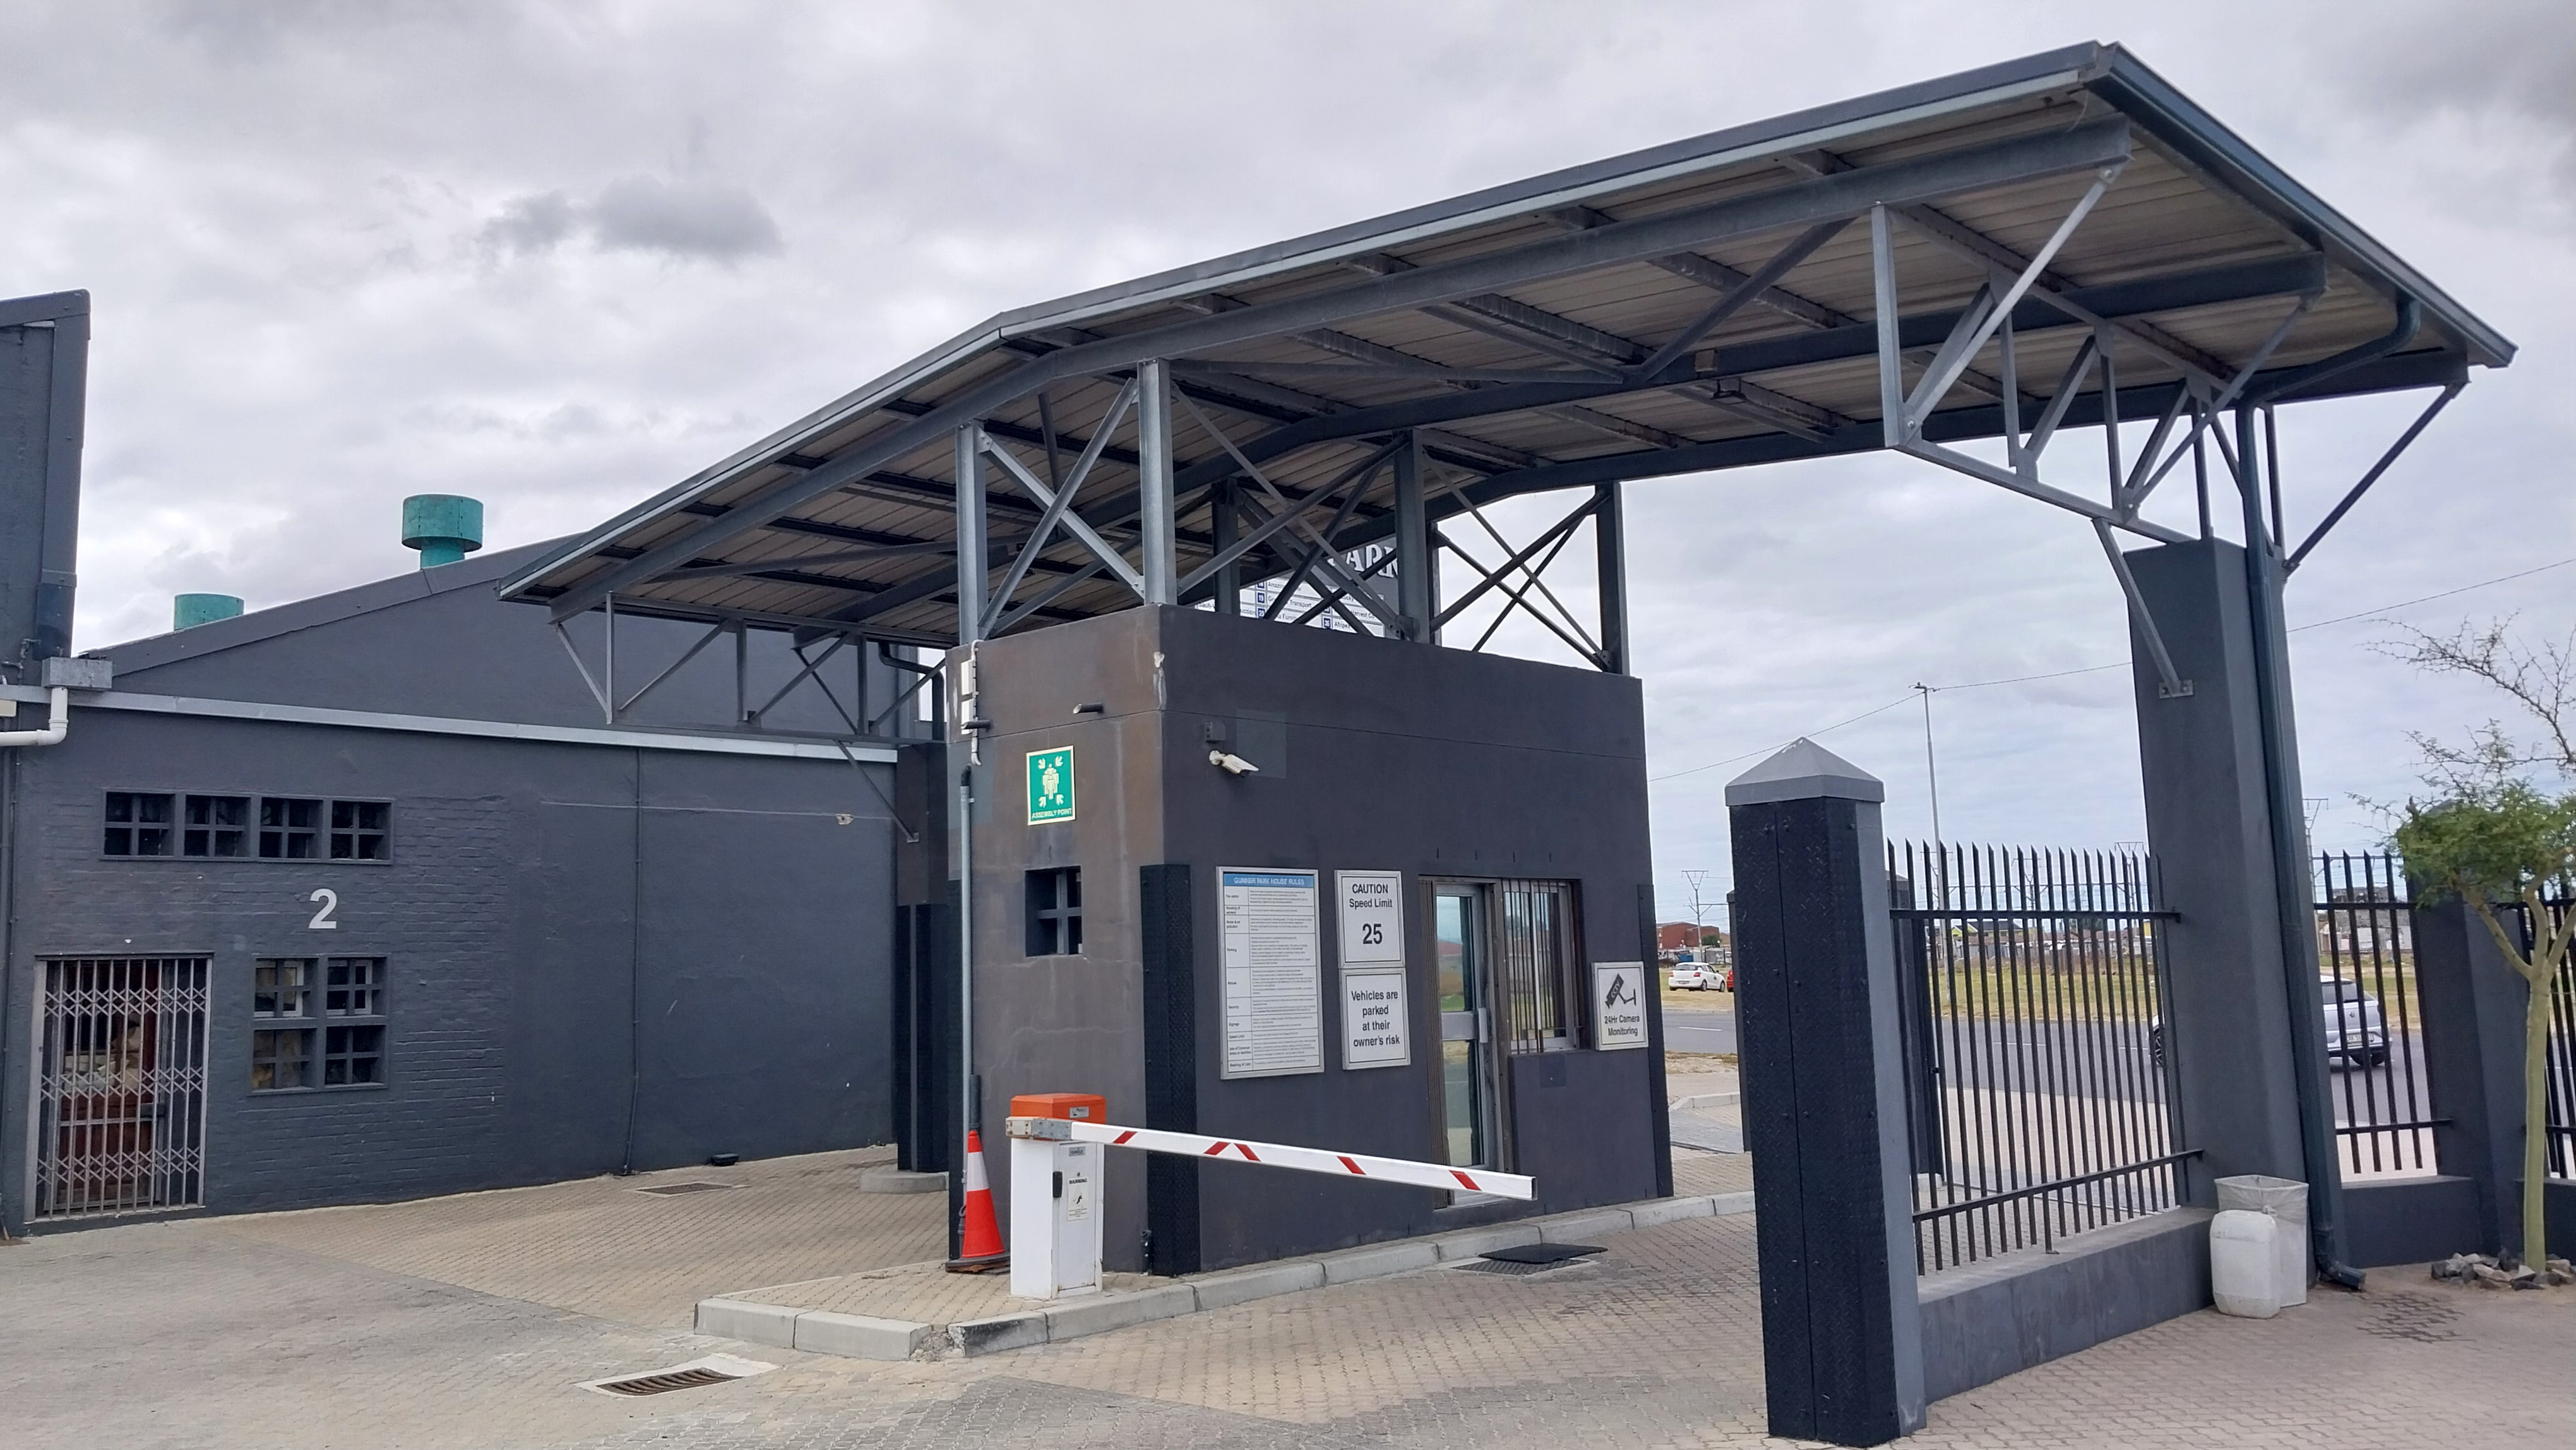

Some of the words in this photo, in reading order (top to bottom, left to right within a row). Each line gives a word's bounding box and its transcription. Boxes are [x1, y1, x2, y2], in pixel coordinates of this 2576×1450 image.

[1290, 599, 1312, 608] Transport
[1032, 810, 1057, 819] ASSEMBLY
[1058, 808, 1072, 816] POINT
[1352, 884, 1388, 894] CAUTION
[308, 888, 337, 929] 2
[1349, 898, 1372, 910] Speed
[1374, 898, 1393, 908] Limit
[1363, 923, 1383, 944] 25
[1611, 980, 1620, 998] CCTV
[1351, 990, 1384, 1001] Vehicles
[1386, 991, 1398, 1000] are
[1363, 1005, 1389, 1018] parked
[1604, 1016, 1618, 1024] 24Hr
[1619, 1014, 1640, 1023] Camera
[1363, 1021, 1370, 1031] at
[1372, 1020, 1390, 1030] their
[1608, 1027, 1638, 1036] Monitoring
[1353, 1036, 1384, 1047] owner's
[1386, 1034, 1400, 1045] risk
